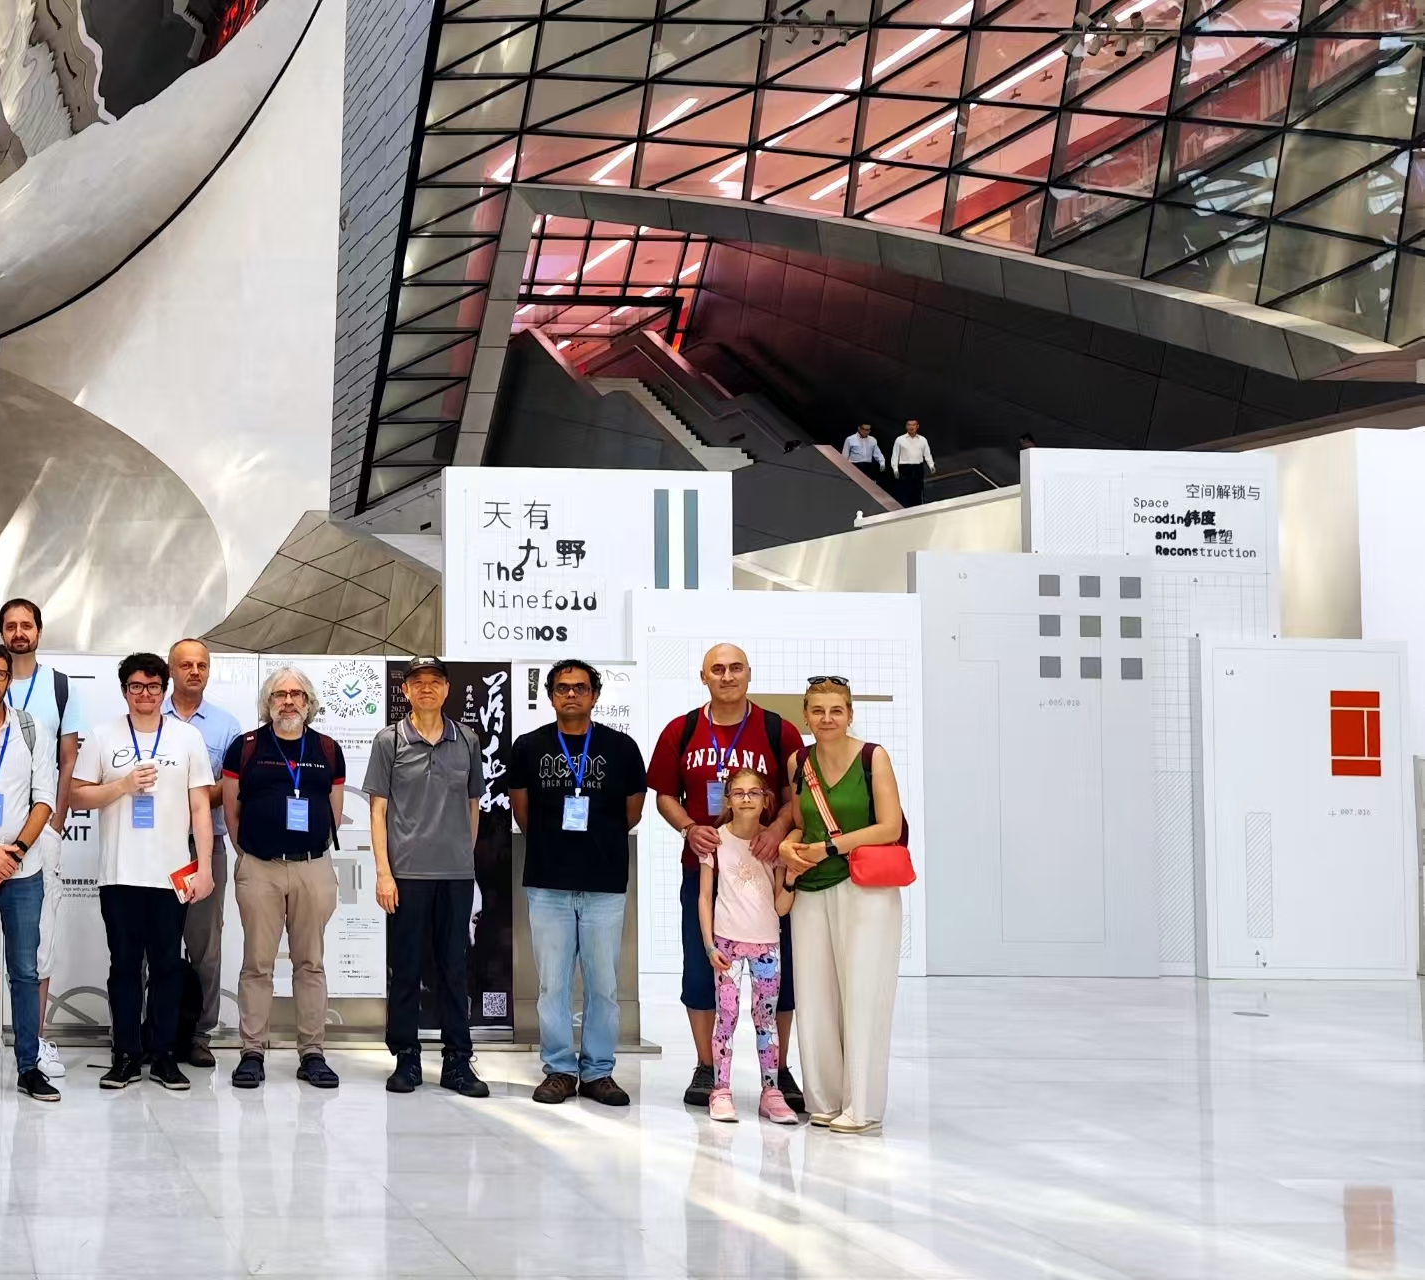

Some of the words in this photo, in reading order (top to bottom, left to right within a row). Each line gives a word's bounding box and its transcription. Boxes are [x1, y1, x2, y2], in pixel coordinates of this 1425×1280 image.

[1185, 484, 1261, 500] 空间解锁与
[1133, 497, 1169, 509] Space
[1133, 513, 1192, 527] Decoding
[1155, 529, 1177, 540] and
[518, 538, 586, 569] 九野
[1155, 545, 1257, 558] Reconstruction
[483, 562, 524, 581] The
[483, 590, 597, 611] Ninefold
[483, 622, 568, 641] Cosmos
[391, 685, 403, 694] Th
[687, 748, 768, 775] INDIANA
[581, 780, 602, 789] LACK
[62, 826, 91, 841] XIT
